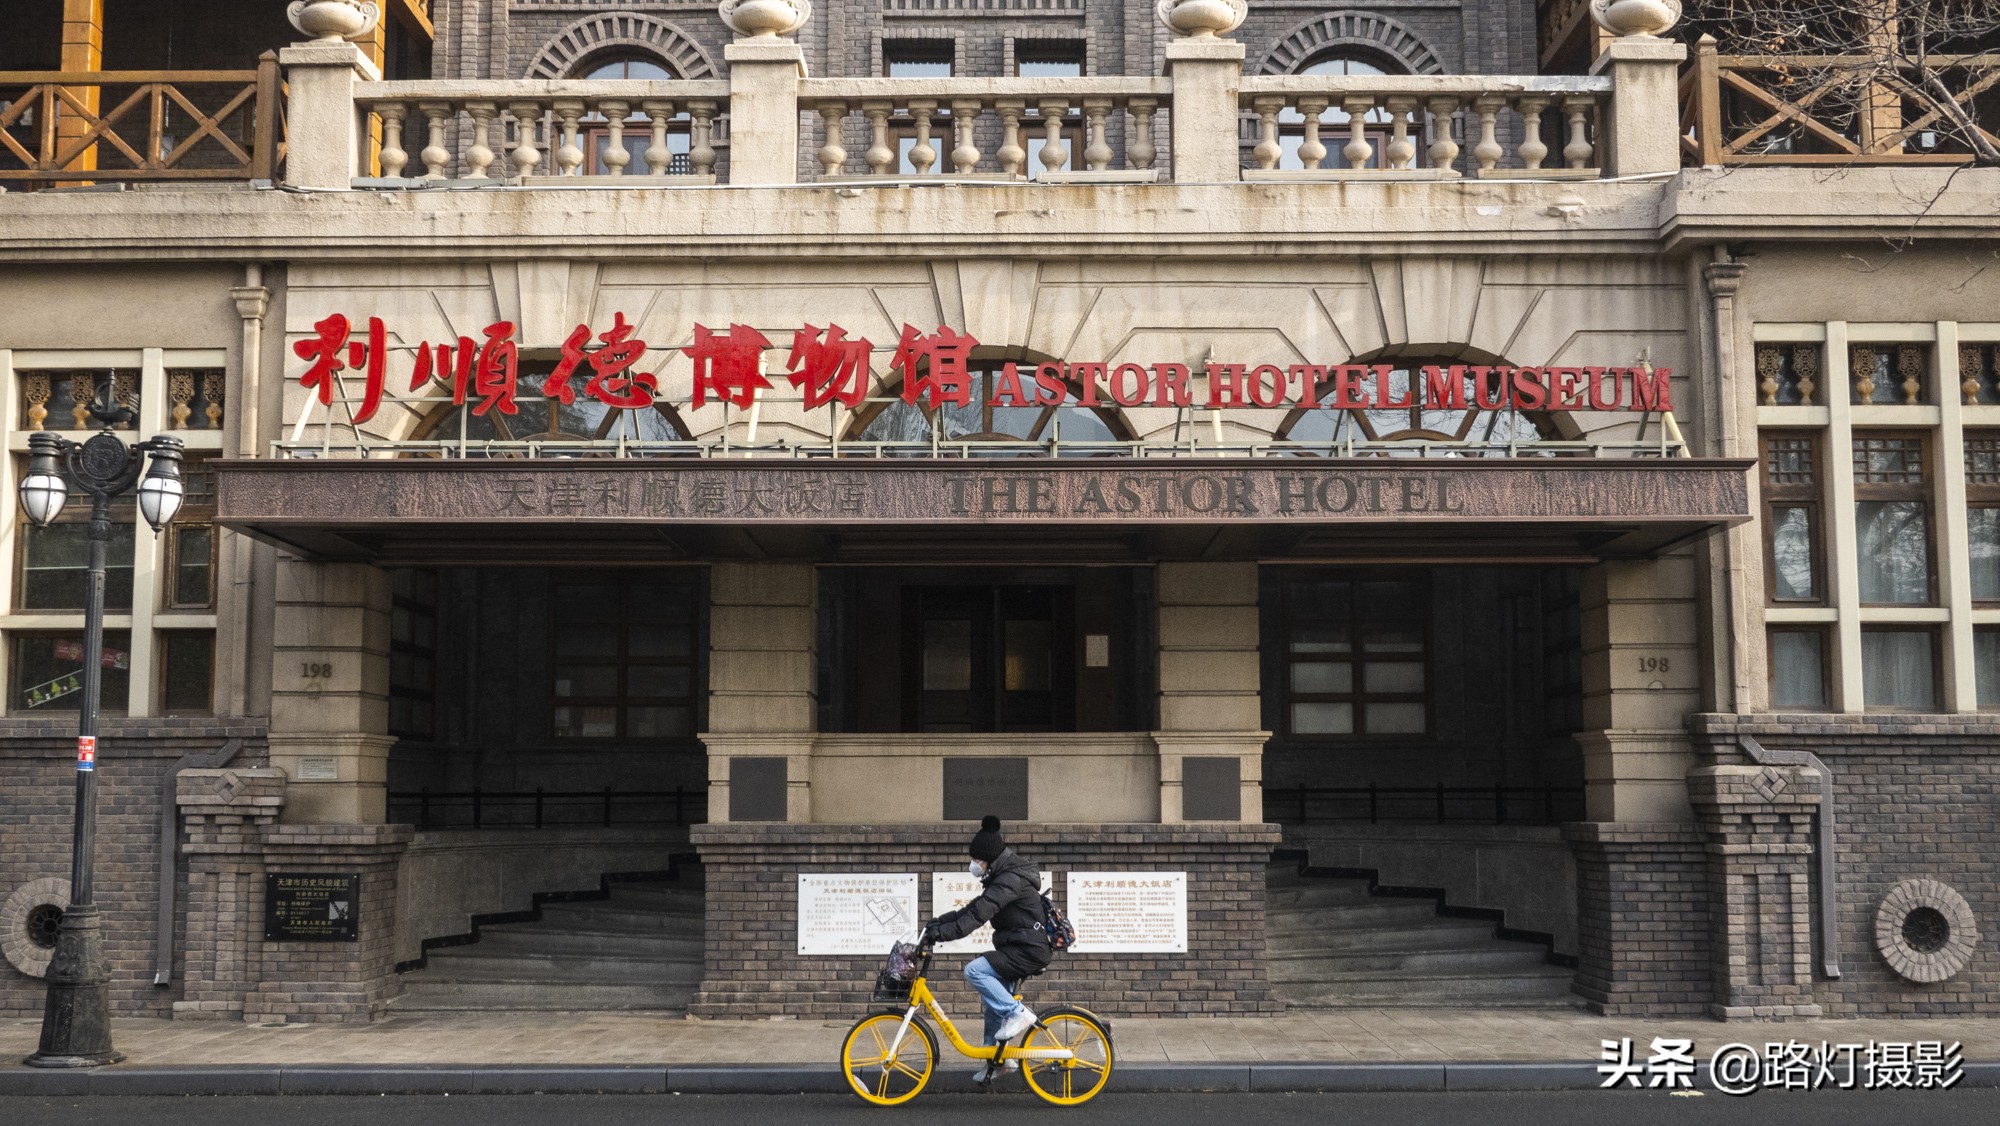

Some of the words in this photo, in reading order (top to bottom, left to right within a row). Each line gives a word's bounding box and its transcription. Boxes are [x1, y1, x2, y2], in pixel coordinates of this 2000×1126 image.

[987, 361, 1193, 408] ASTOR
[1204, 363, 1412, 410] HOTEL
[1420, 364, 1674, 412] MUSEUM
[495, 477, 868, 515] 天津利顺德大饭店
[942, 475, 1054, 513] THE
[1072, 475, 1259, 513] ASTOR
[1275, 475, 1465, 513] HOTEL
[301, 663, 332, 678] 198
[1638, 657, 1669, 673] 198
